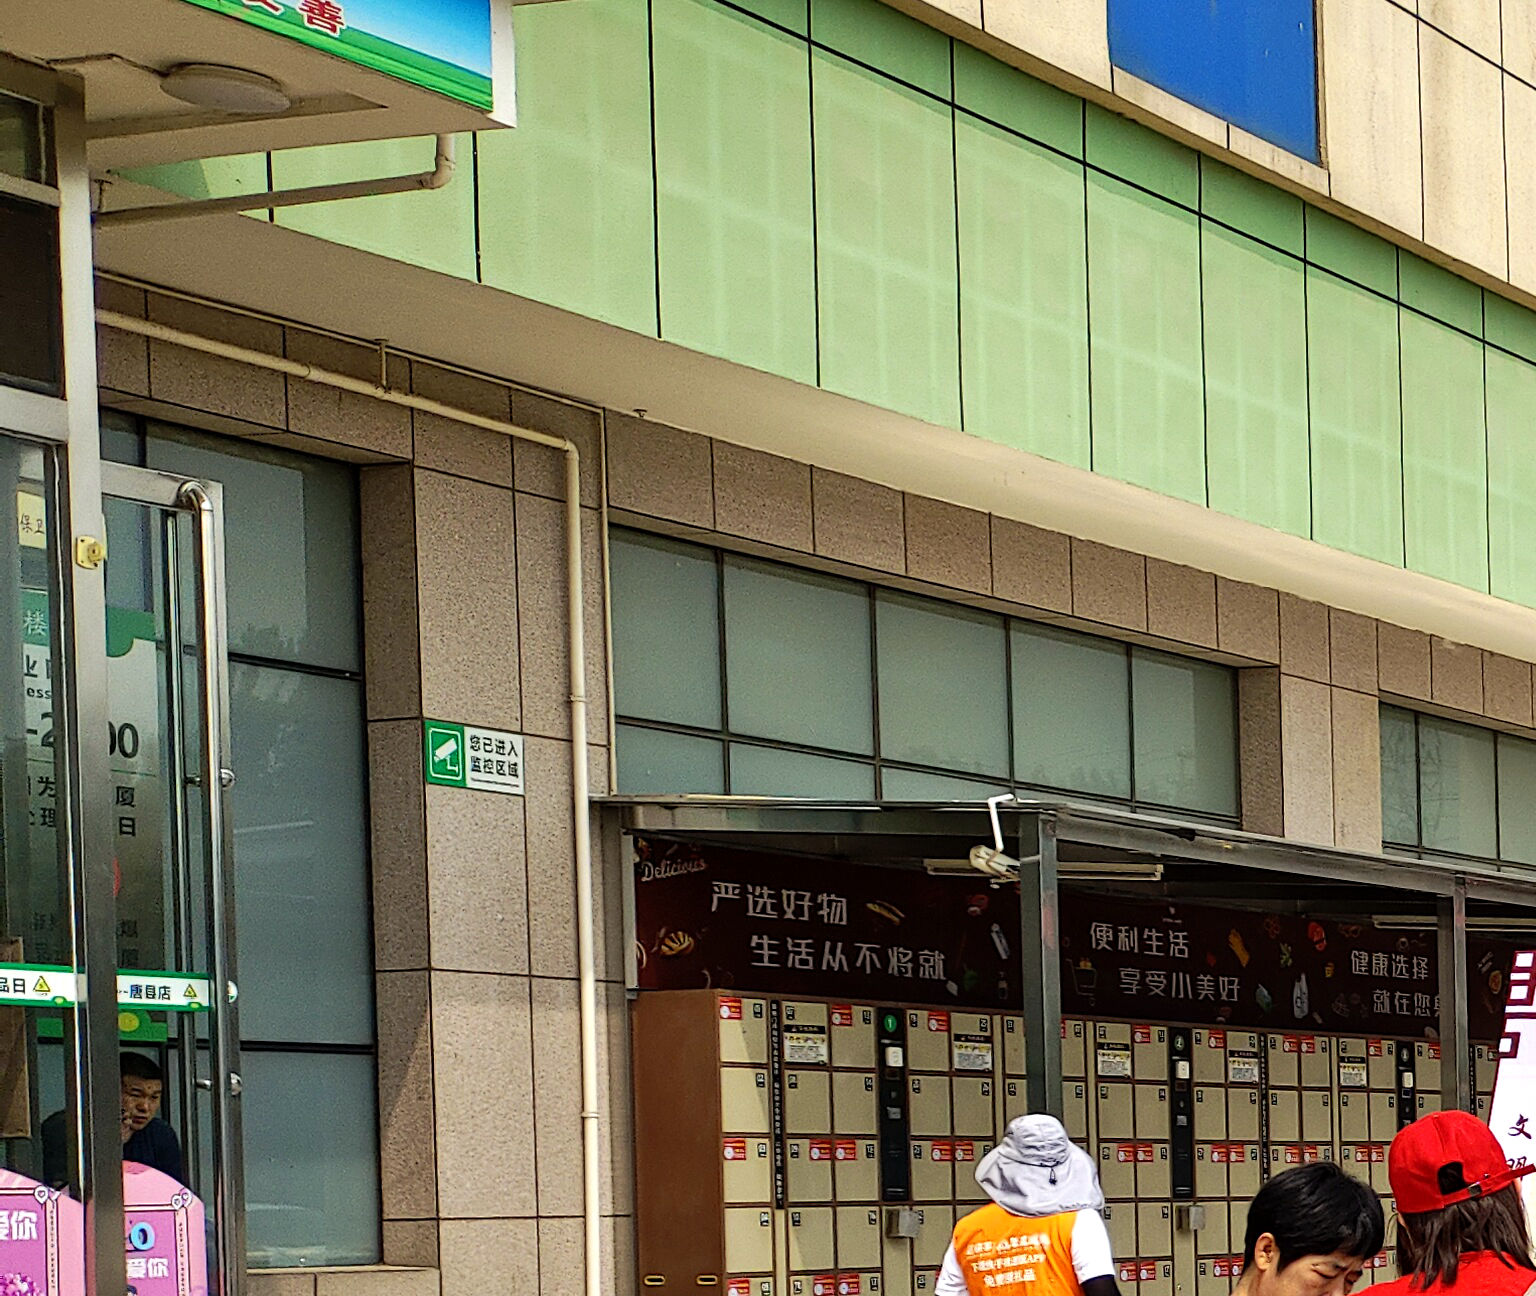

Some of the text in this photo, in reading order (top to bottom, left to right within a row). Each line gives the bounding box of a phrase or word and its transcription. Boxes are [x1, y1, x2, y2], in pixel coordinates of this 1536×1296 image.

[469, 734, 519, 757] 您已进入
[470, 755, 519, 779] 监控区域
[710, 880, 849, 926] 严选好物
[749, 934, 948, 981] 生活从不将就
[1090, 921, 1190, 959] 便利生活
[1351, 949, 1430, 981] 健康选择
[1118, 967, 1242, 1002] 享受小美好
